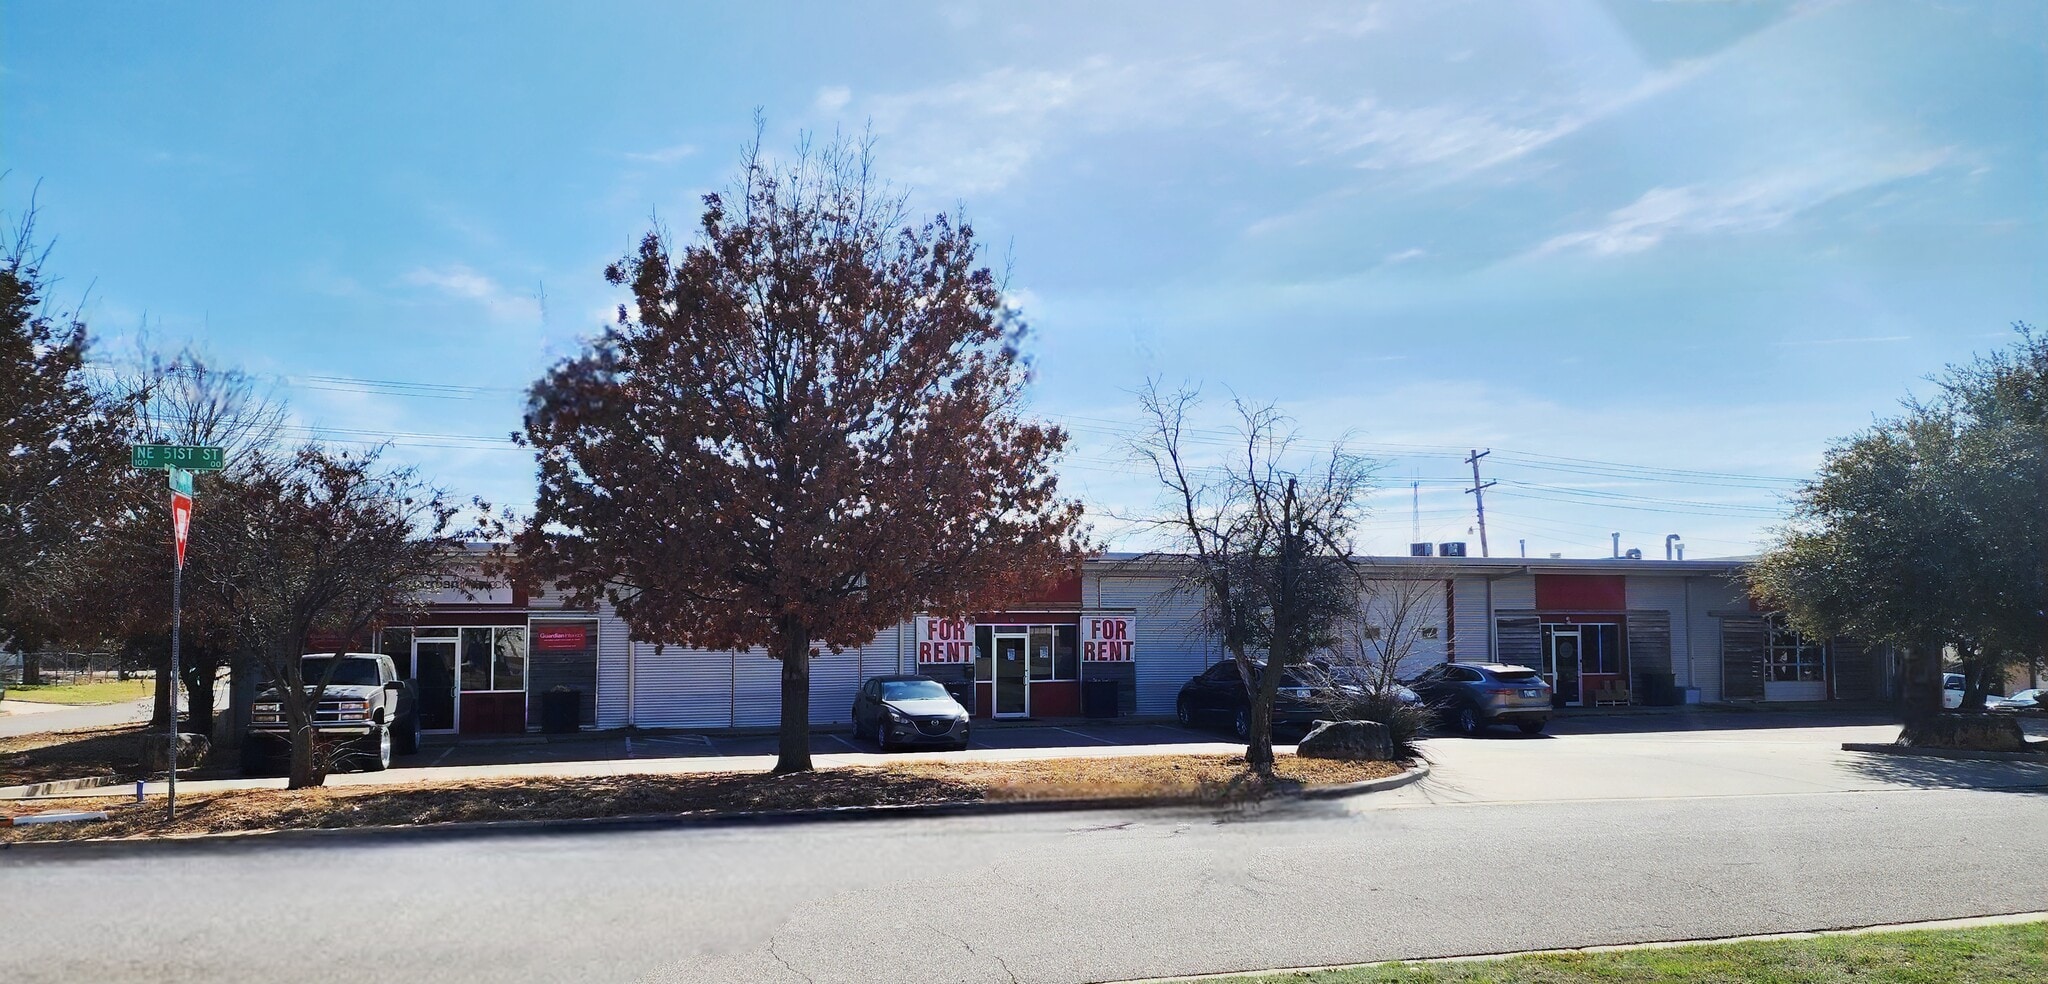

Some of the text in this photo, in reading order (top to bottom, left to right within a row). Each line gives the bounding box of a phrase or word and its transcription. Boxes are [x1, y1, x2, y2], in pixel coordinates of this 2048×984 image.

[137, 447, 219, 460] NE 51ST ST
[927, 619, 965, 640] FOR
[1091, 619, 1127, 640] FOR
[919, 641, 973, 663] RENT
[1083, 641, 1134, 661] RENT
